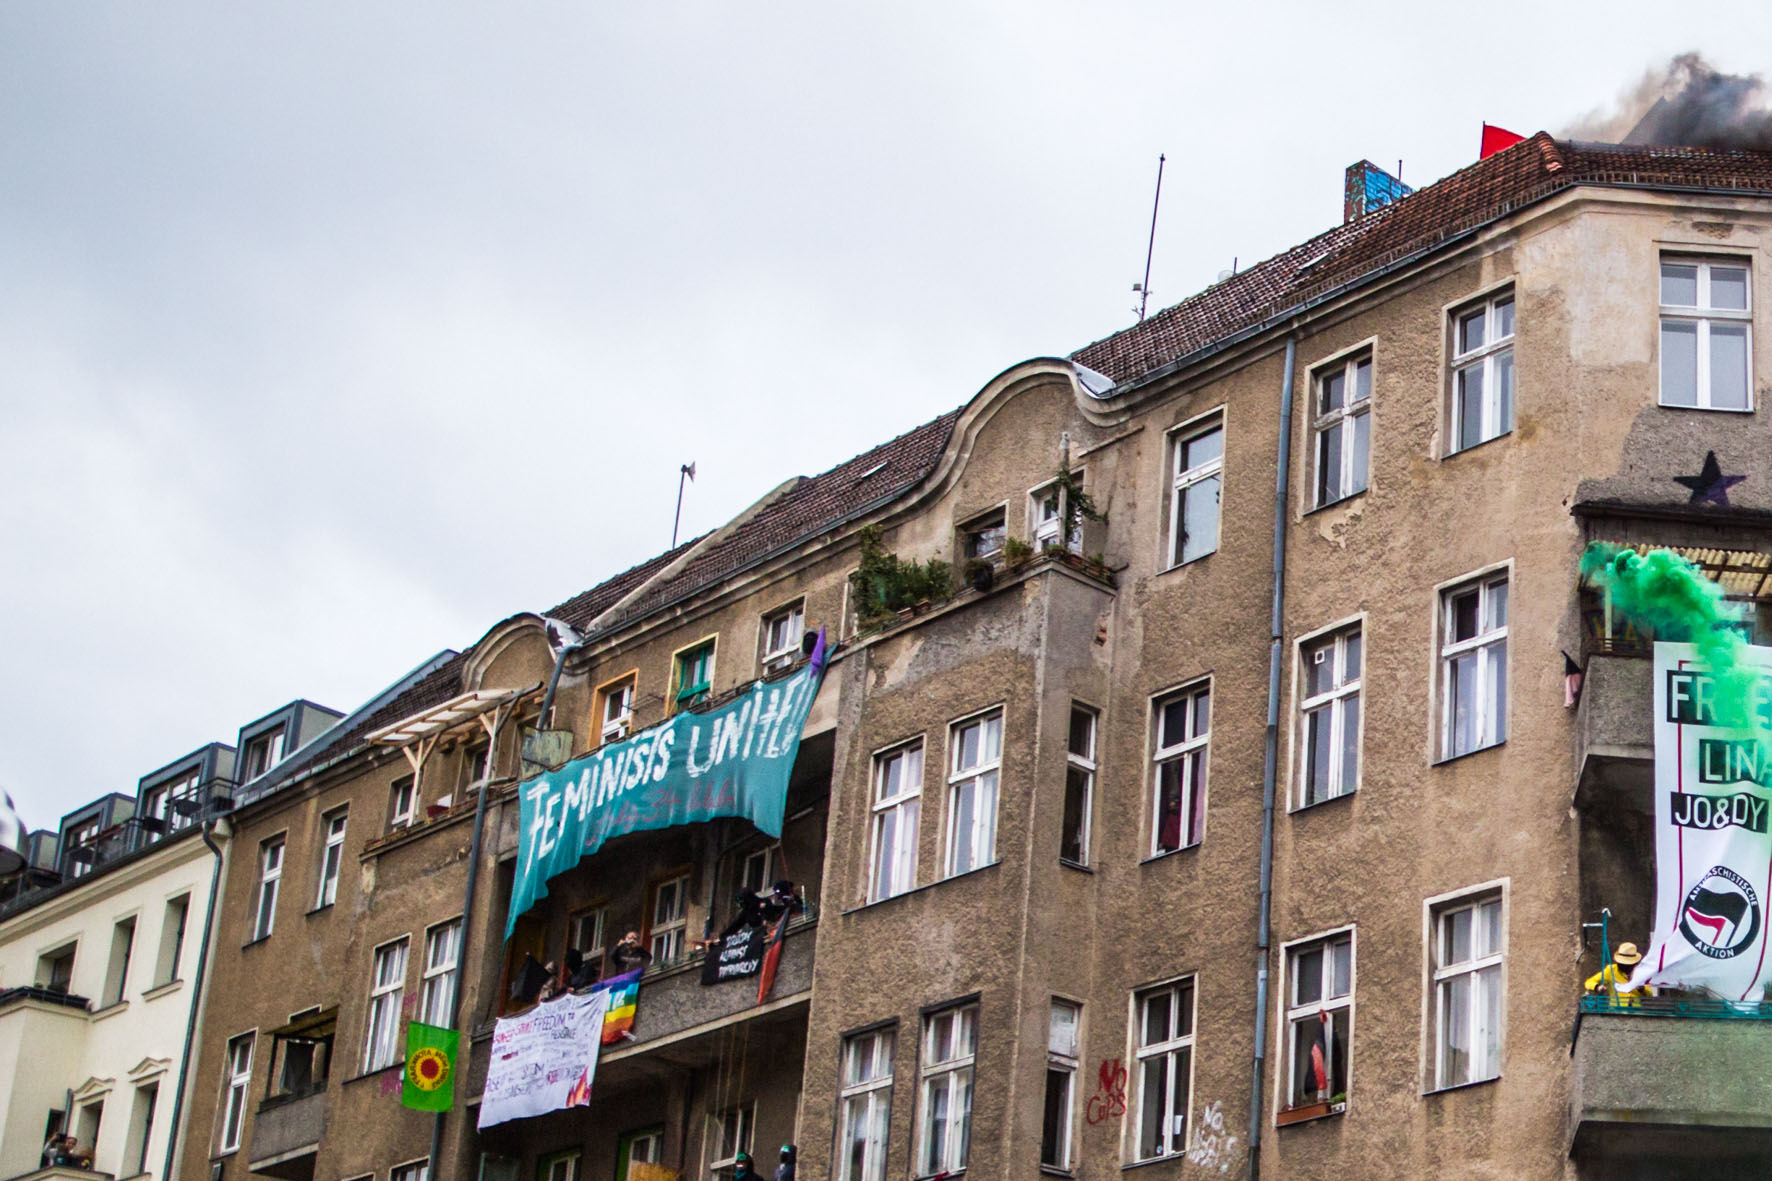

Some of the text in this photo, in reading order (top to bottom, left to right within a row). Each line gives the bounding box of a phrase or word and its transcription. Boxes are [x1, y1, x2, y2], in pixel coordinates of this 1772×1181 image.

[525, 720, 676, 878] FEMINISTS
[1675, 794, 1765, 830] JO&DY
[1695, 941, 1734, 957] AKTION
